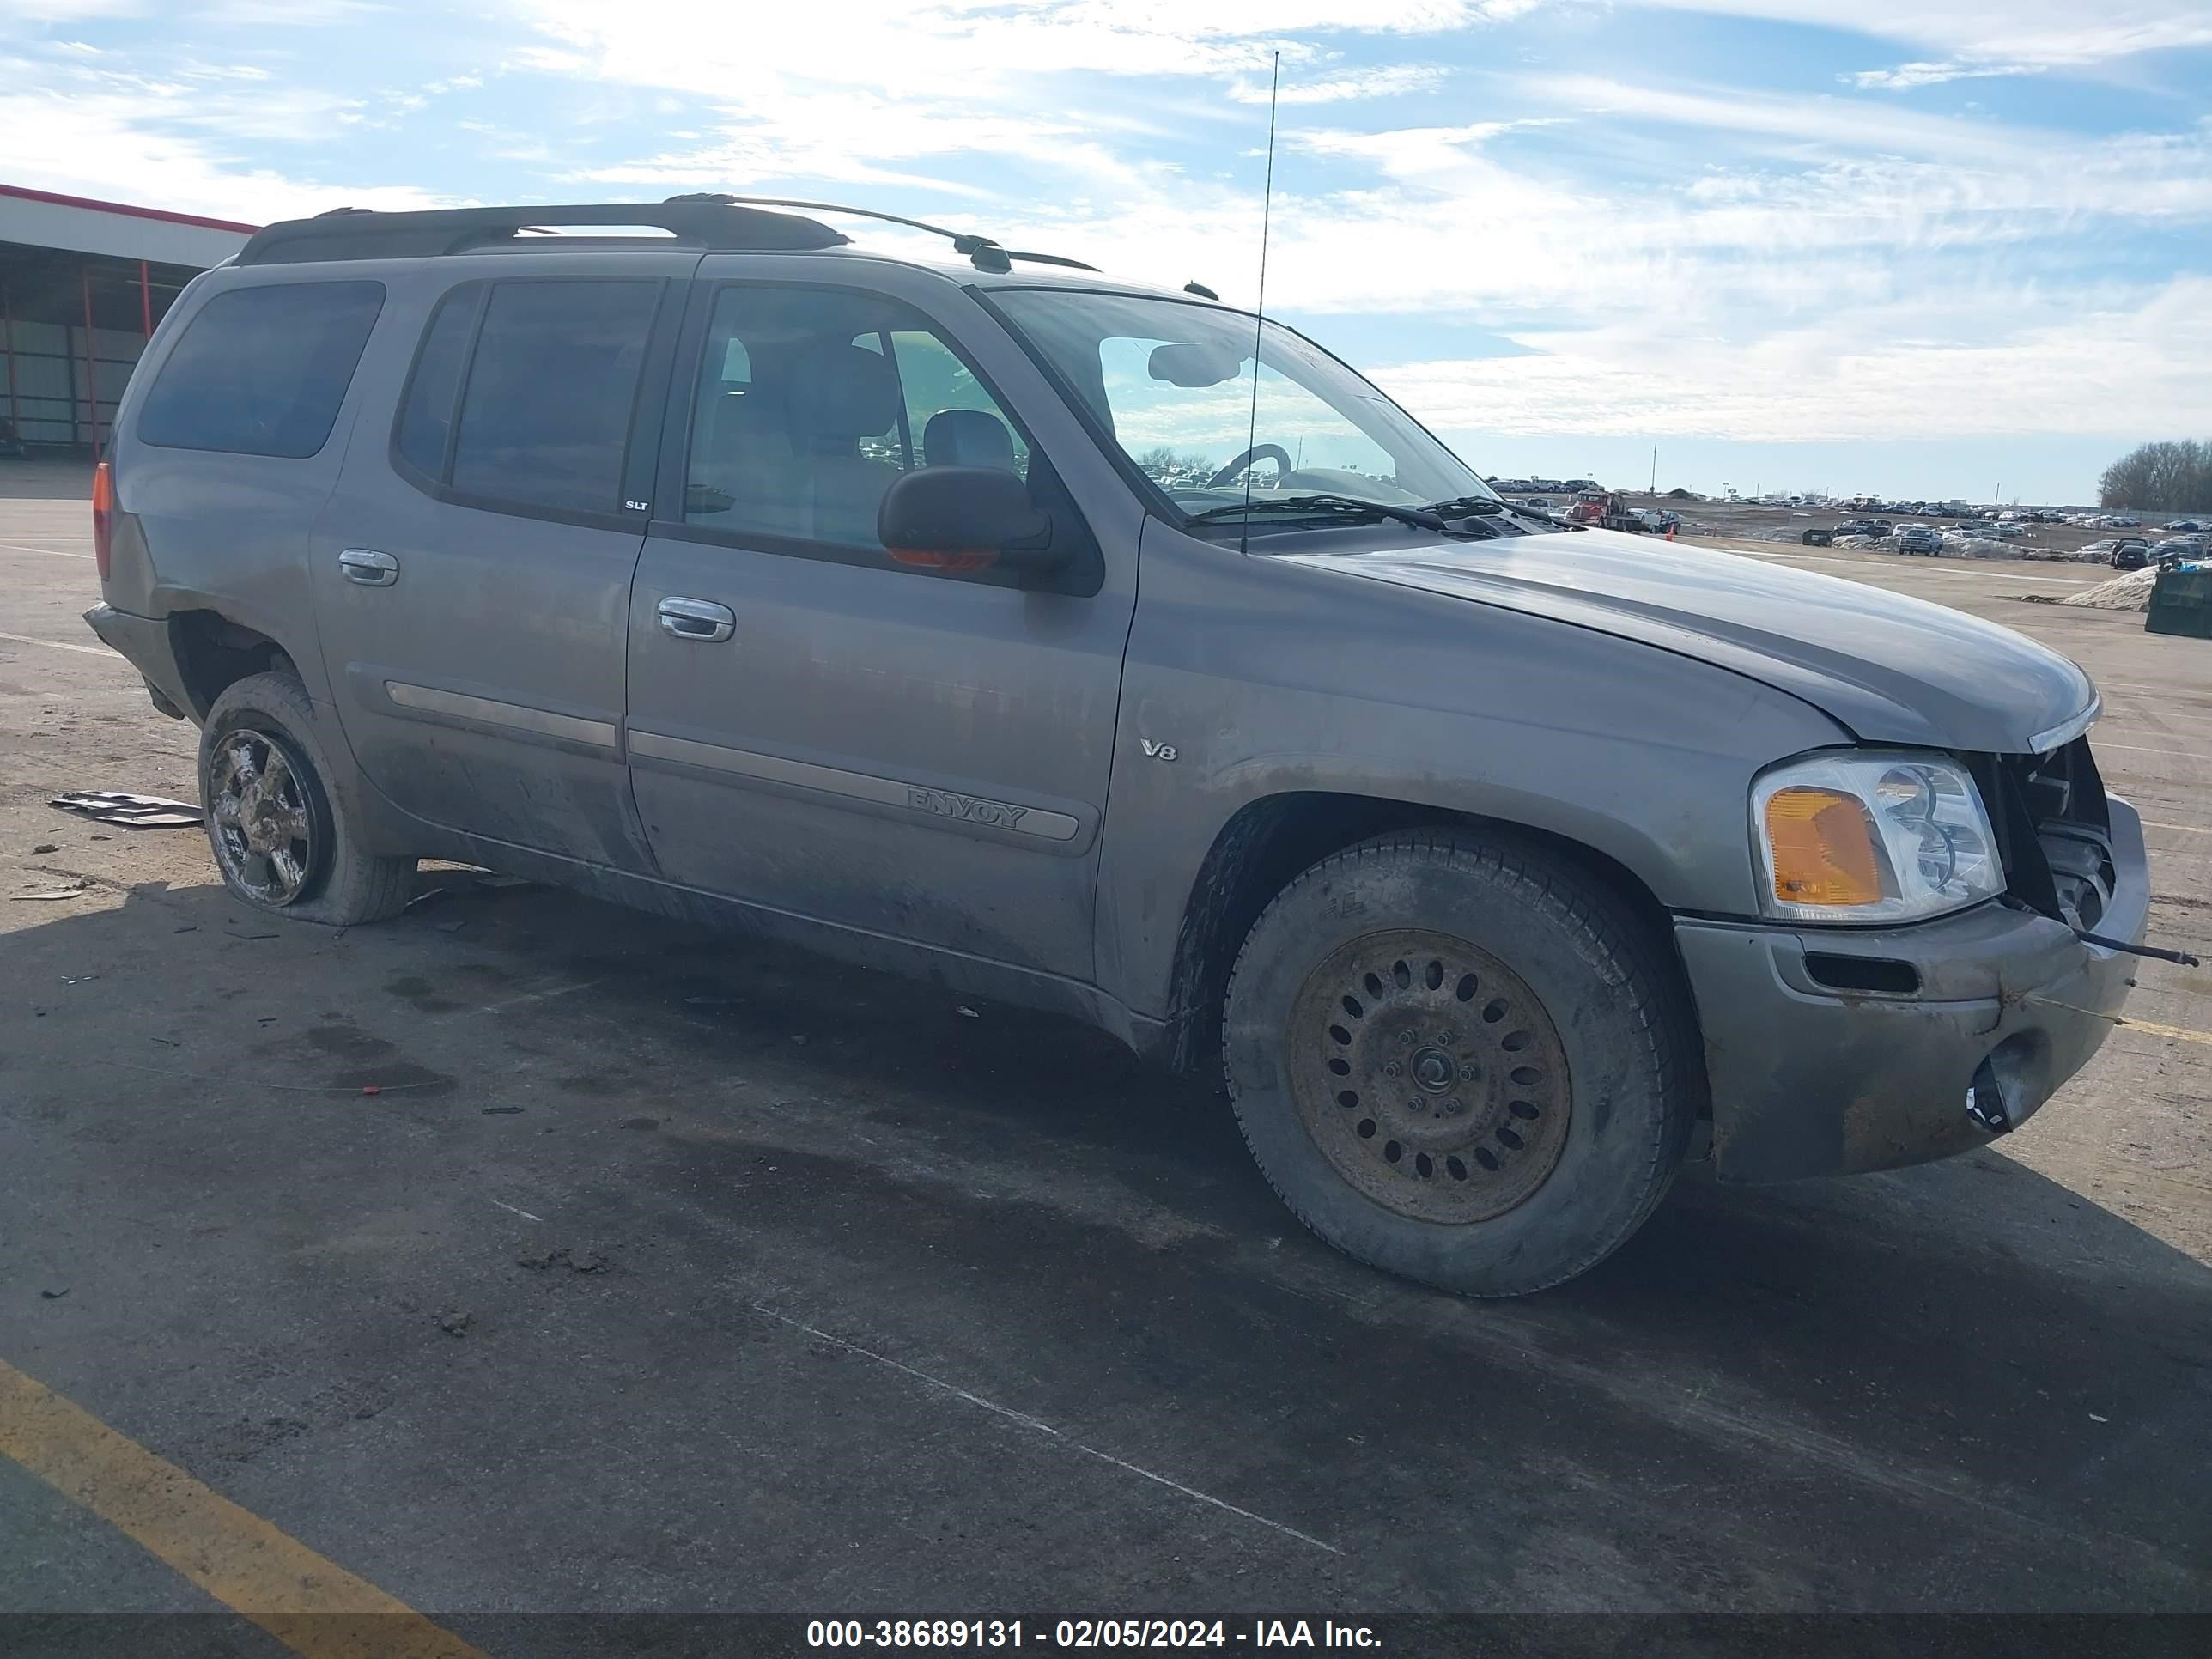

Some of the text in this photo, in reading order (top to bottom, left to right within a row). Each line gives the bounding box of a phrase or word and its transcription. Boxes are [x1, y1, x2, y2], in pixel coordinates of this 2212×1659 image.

[625, 501, 648, 511] SLT
[1140, 738, 1177, 761] V8
[908, 785, 1030, 829] ENVOY
